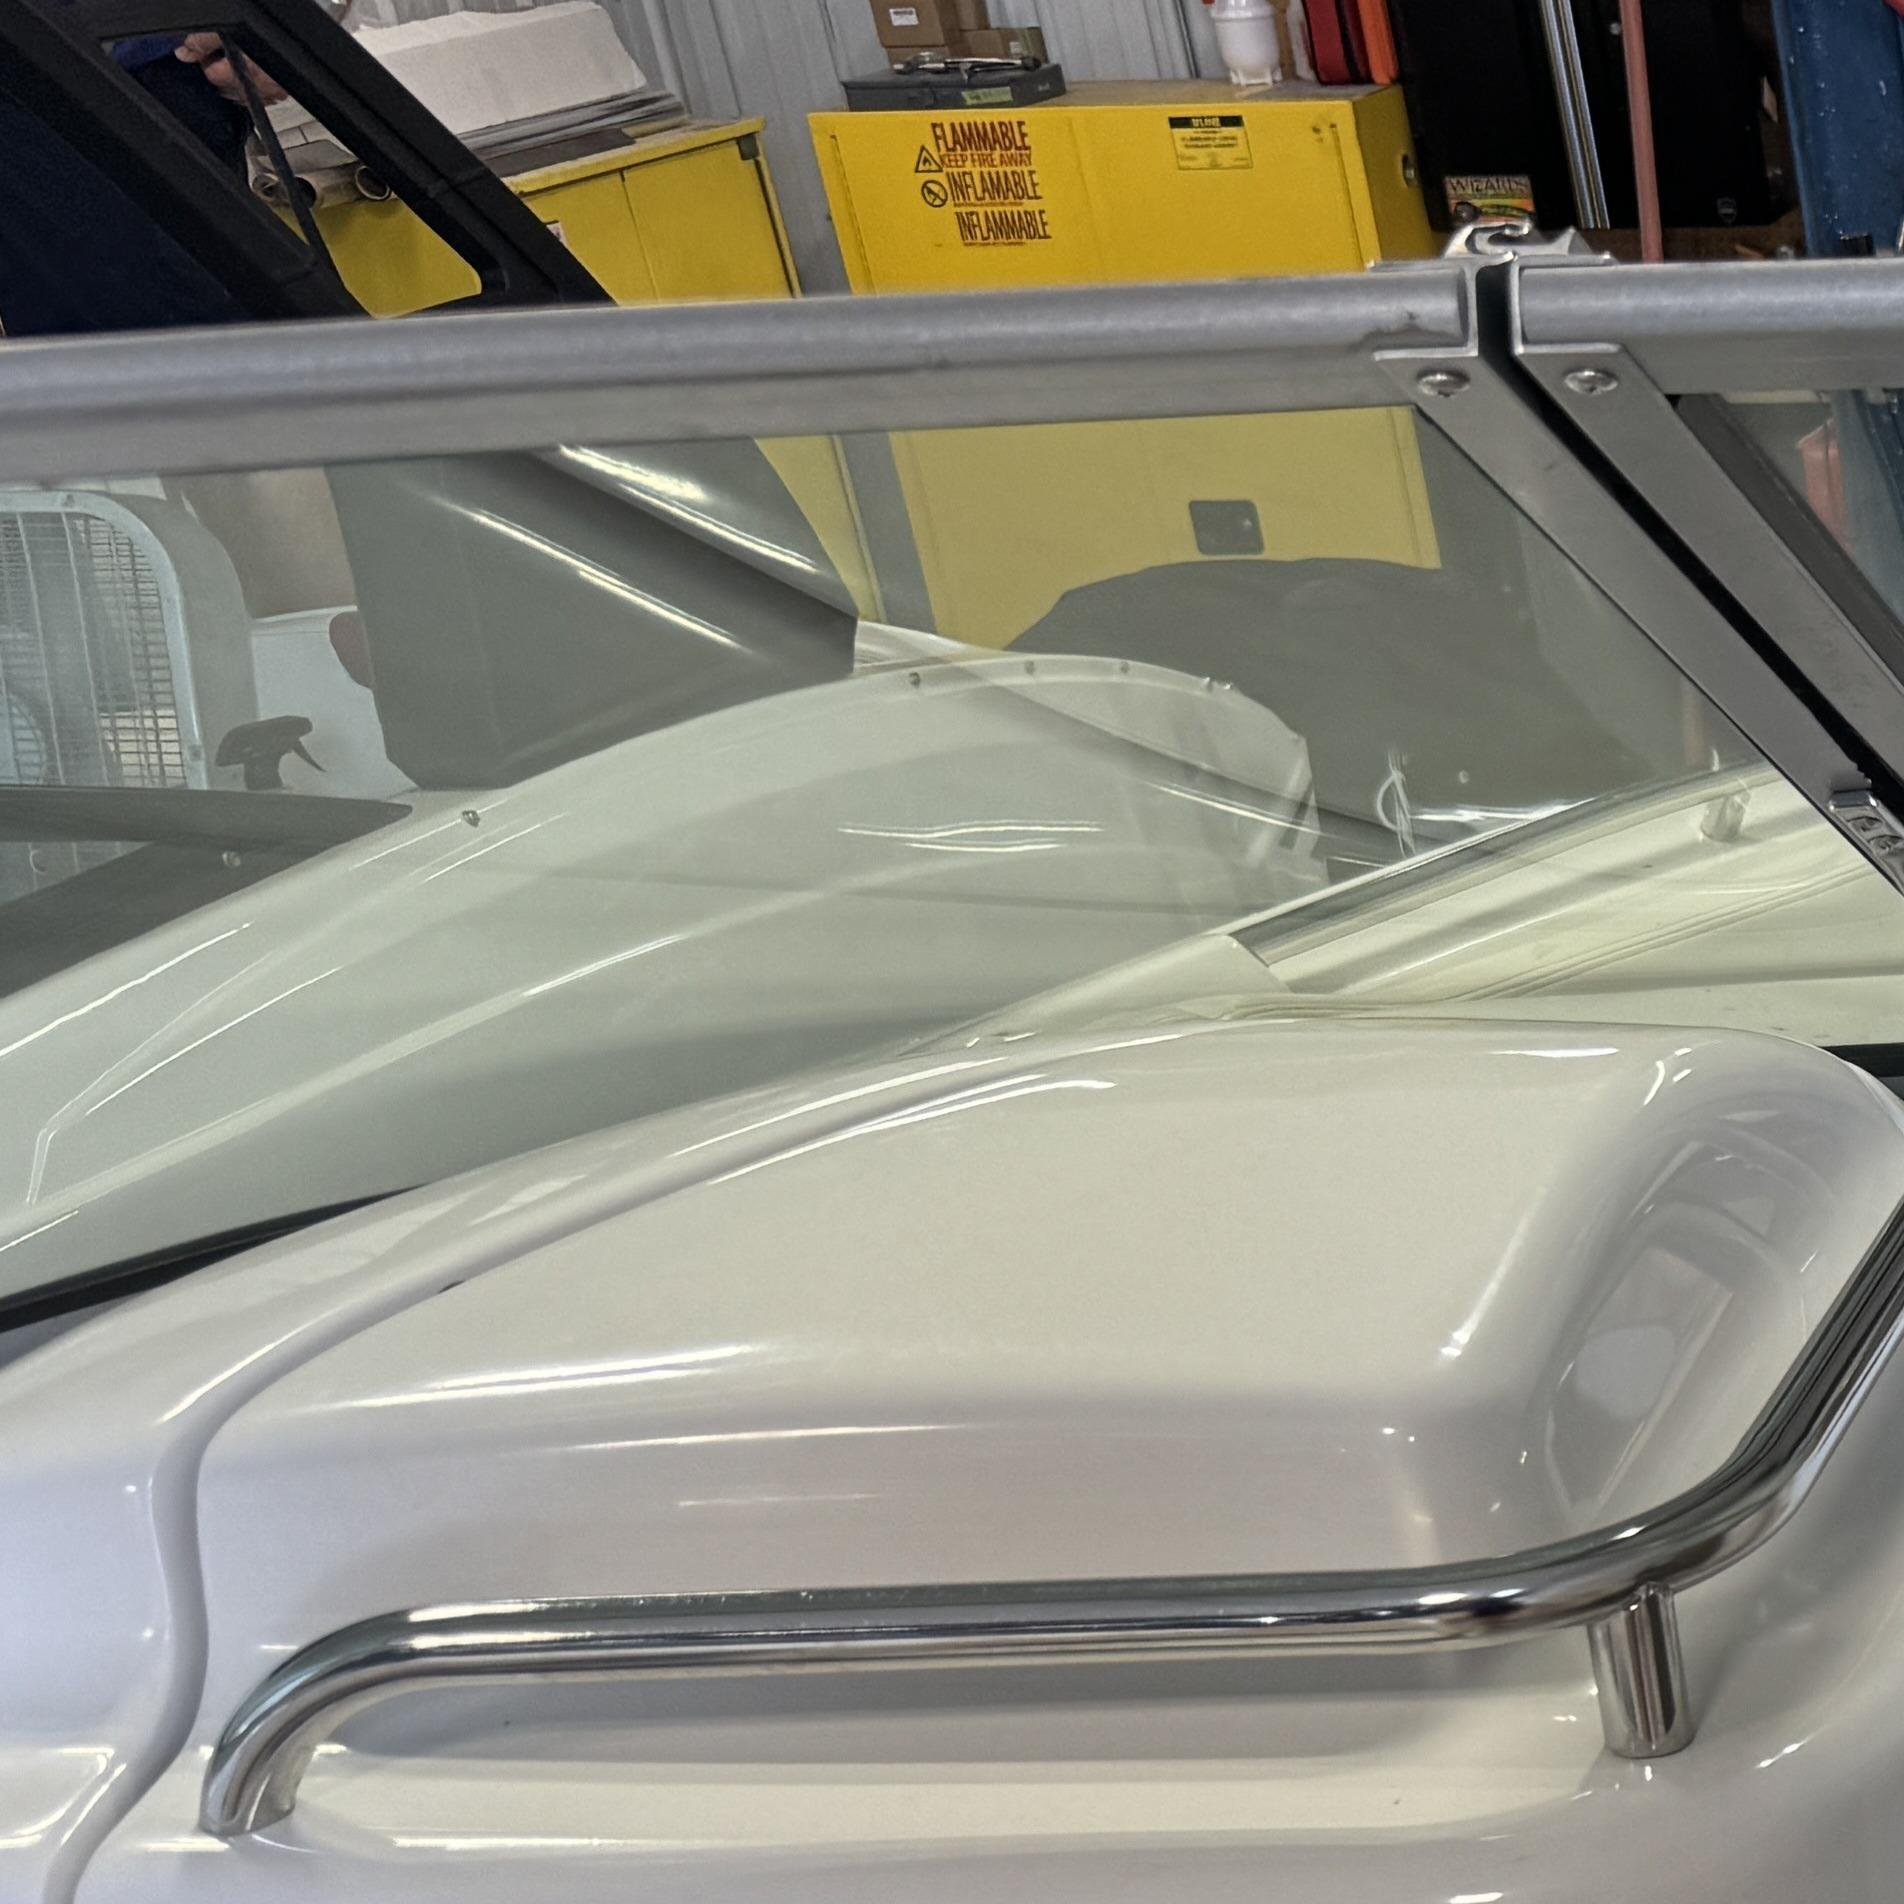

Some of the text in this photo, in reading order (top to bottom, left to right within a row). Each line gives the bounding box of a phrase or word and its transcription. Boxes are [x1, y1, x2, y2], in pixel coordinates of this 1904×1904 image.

[931, 120, 1032, 152] FLAMMABLE
[939, 152, 1032, 168] KEEP FIRE AWAY
[946, 170, 1043, 202] INFLAMABLE
[955, 209, 1052, 241] INFLAMMABLE
